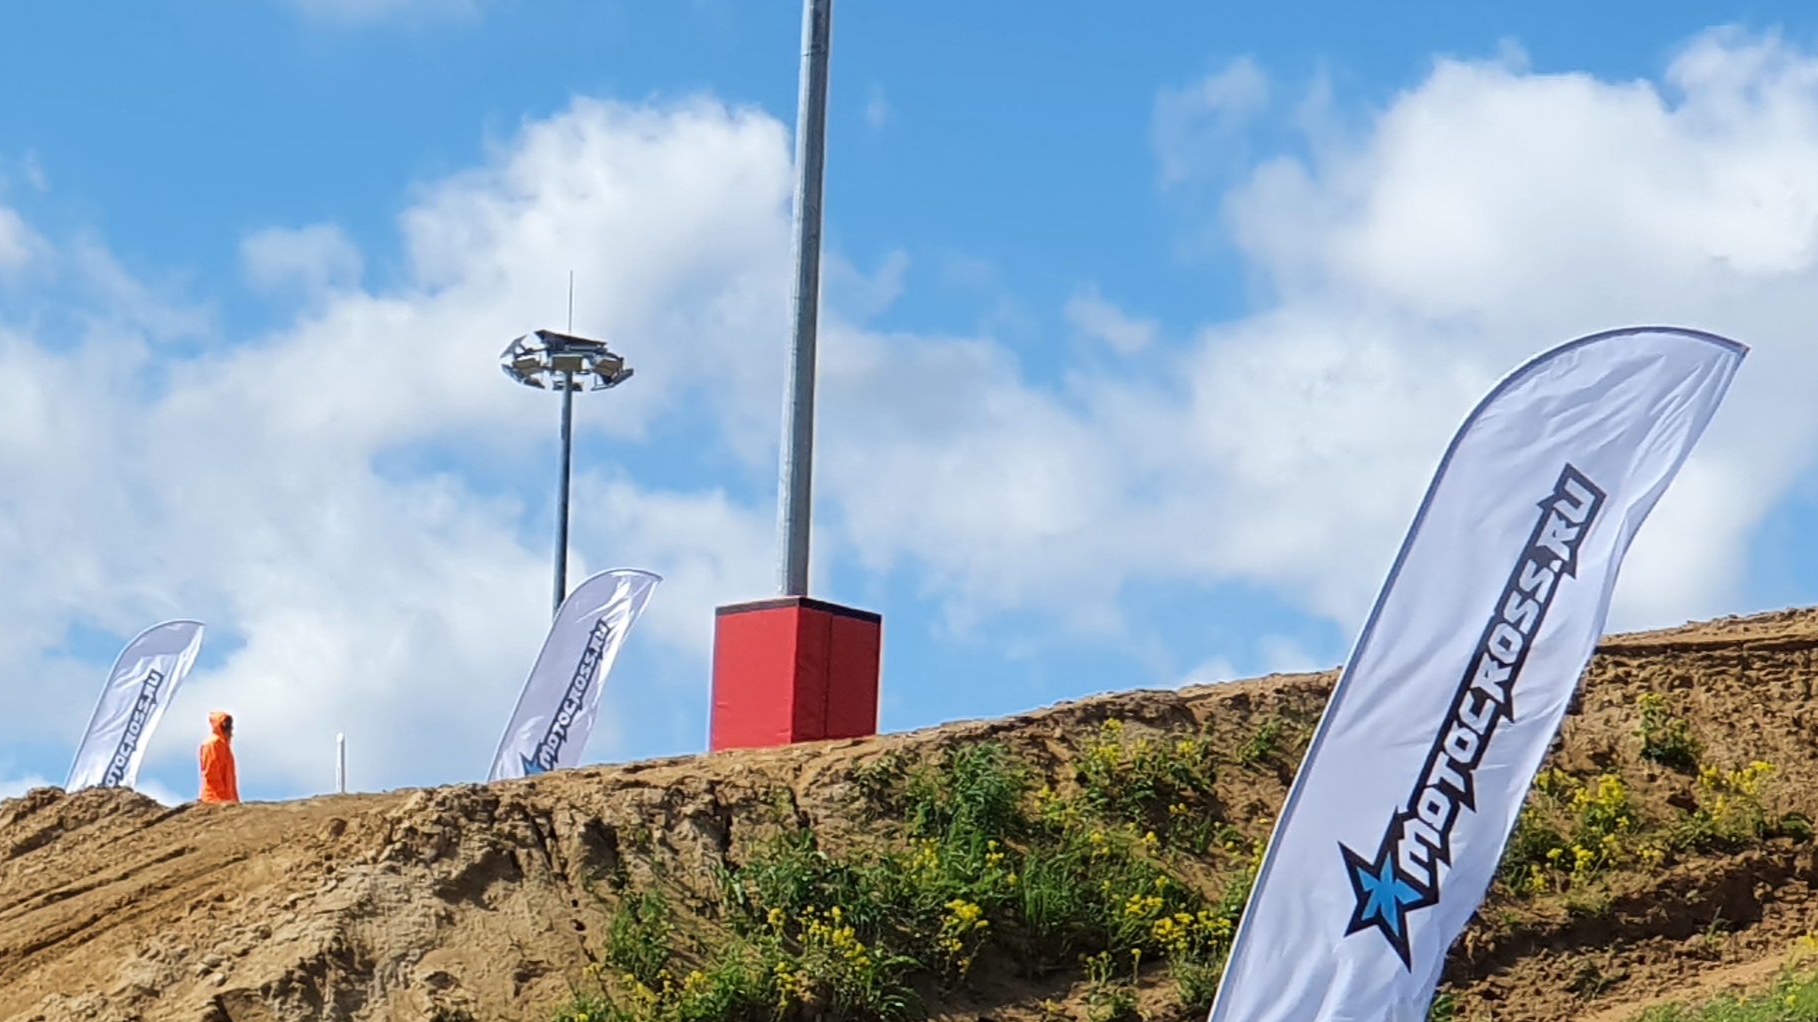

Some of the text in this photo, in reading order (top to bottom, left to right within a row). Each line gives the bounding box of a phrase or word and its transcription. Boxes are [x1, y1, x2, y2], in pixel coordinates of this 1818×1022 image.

[103, 669, 163, 787] OTOCROSS.RU
[537, 619, 610, 771] MOTOCROSS.RU
[1395, 466, 1604, 893] MOTOCROSS.RU
